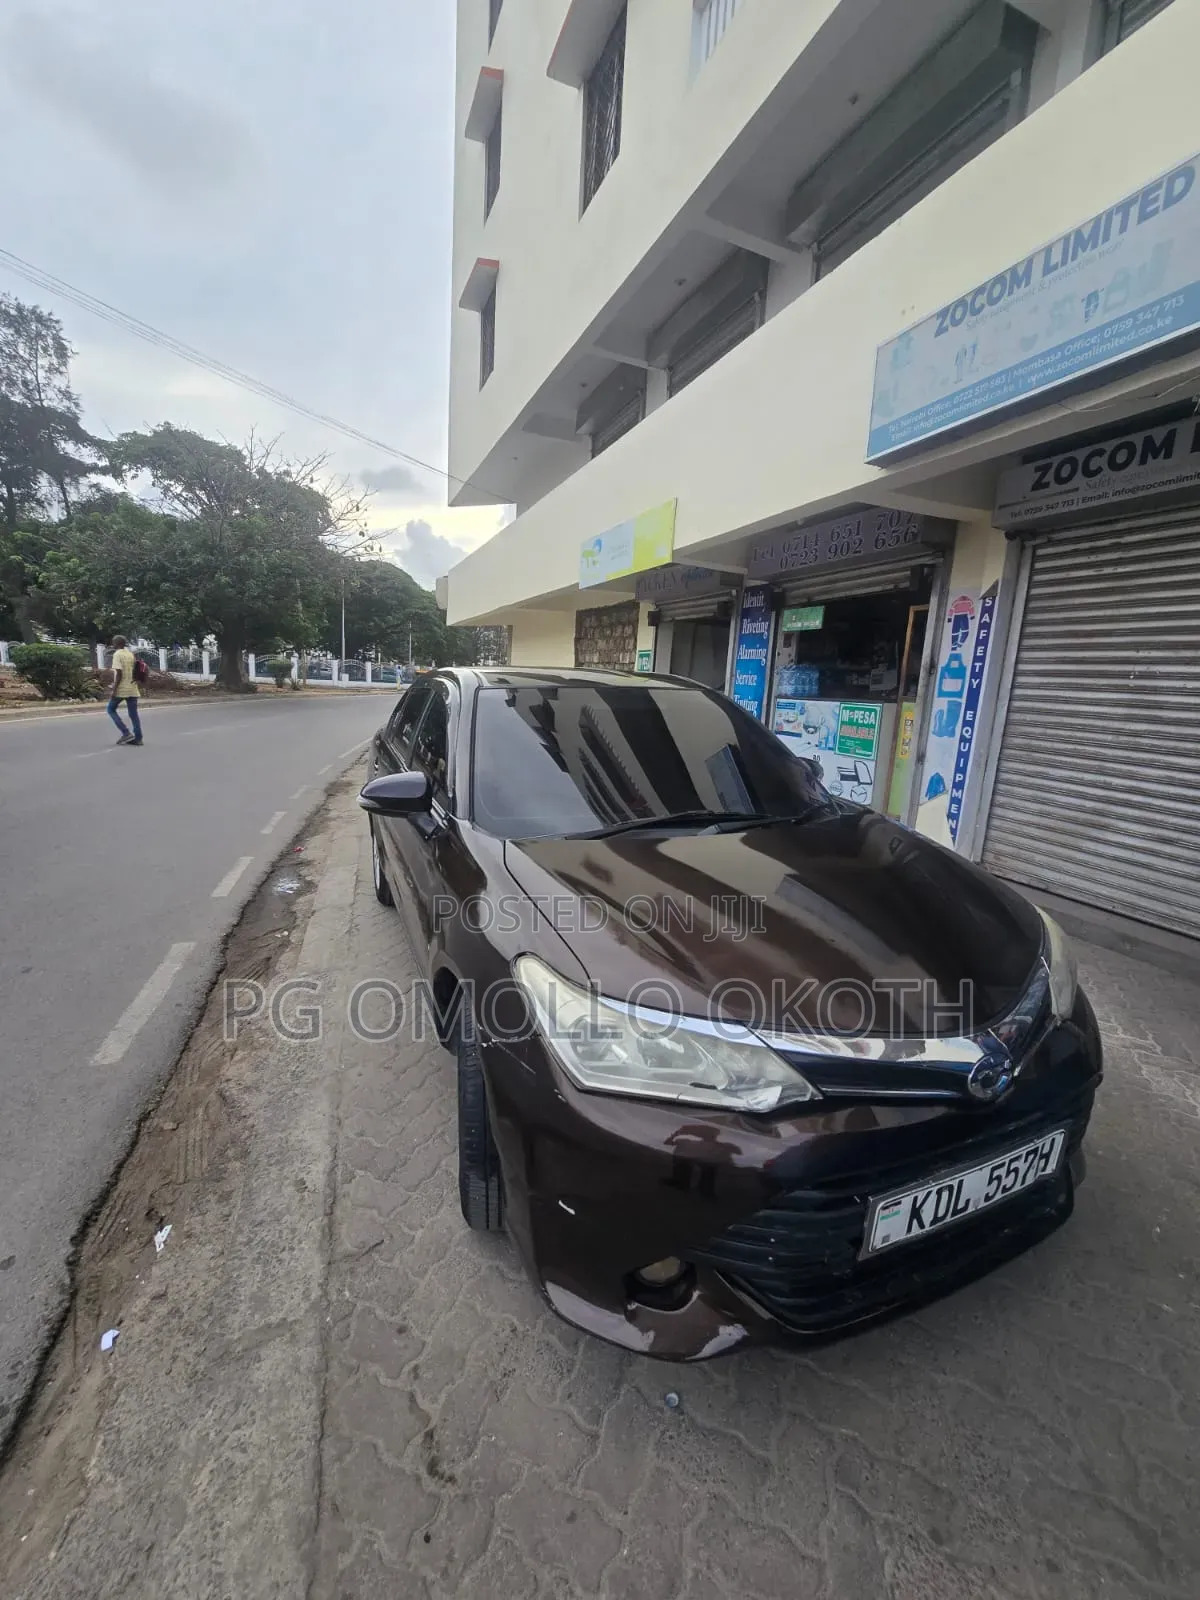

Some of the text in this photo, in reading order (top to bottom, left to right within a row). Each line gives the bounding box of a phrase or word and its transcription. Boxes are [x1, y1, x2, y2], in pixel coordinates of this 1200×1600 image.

[934, 165, 1196, 338] ZOCOM LIMITED
[1013, 351, 1062, 378] Mombasa
[1104, 318, 1133, 338] 0759
[1030, 427, 1178, 492] ZOCOM
[779, 525, 919, 570] 0723 902 656
[830, 520, 863, 542] 651
[875, 509, 915, 532] 707
[737, 644, 767, 667] Alarming
[742, 616, 769, 639] Riveting
[970, 597, 993, 689] SAFETY
[736, 670, 758, 686] Service
[948, 711, 974, 838] EQUIPMEN
[905, 1138, 1056, 1236] KDL 557H
